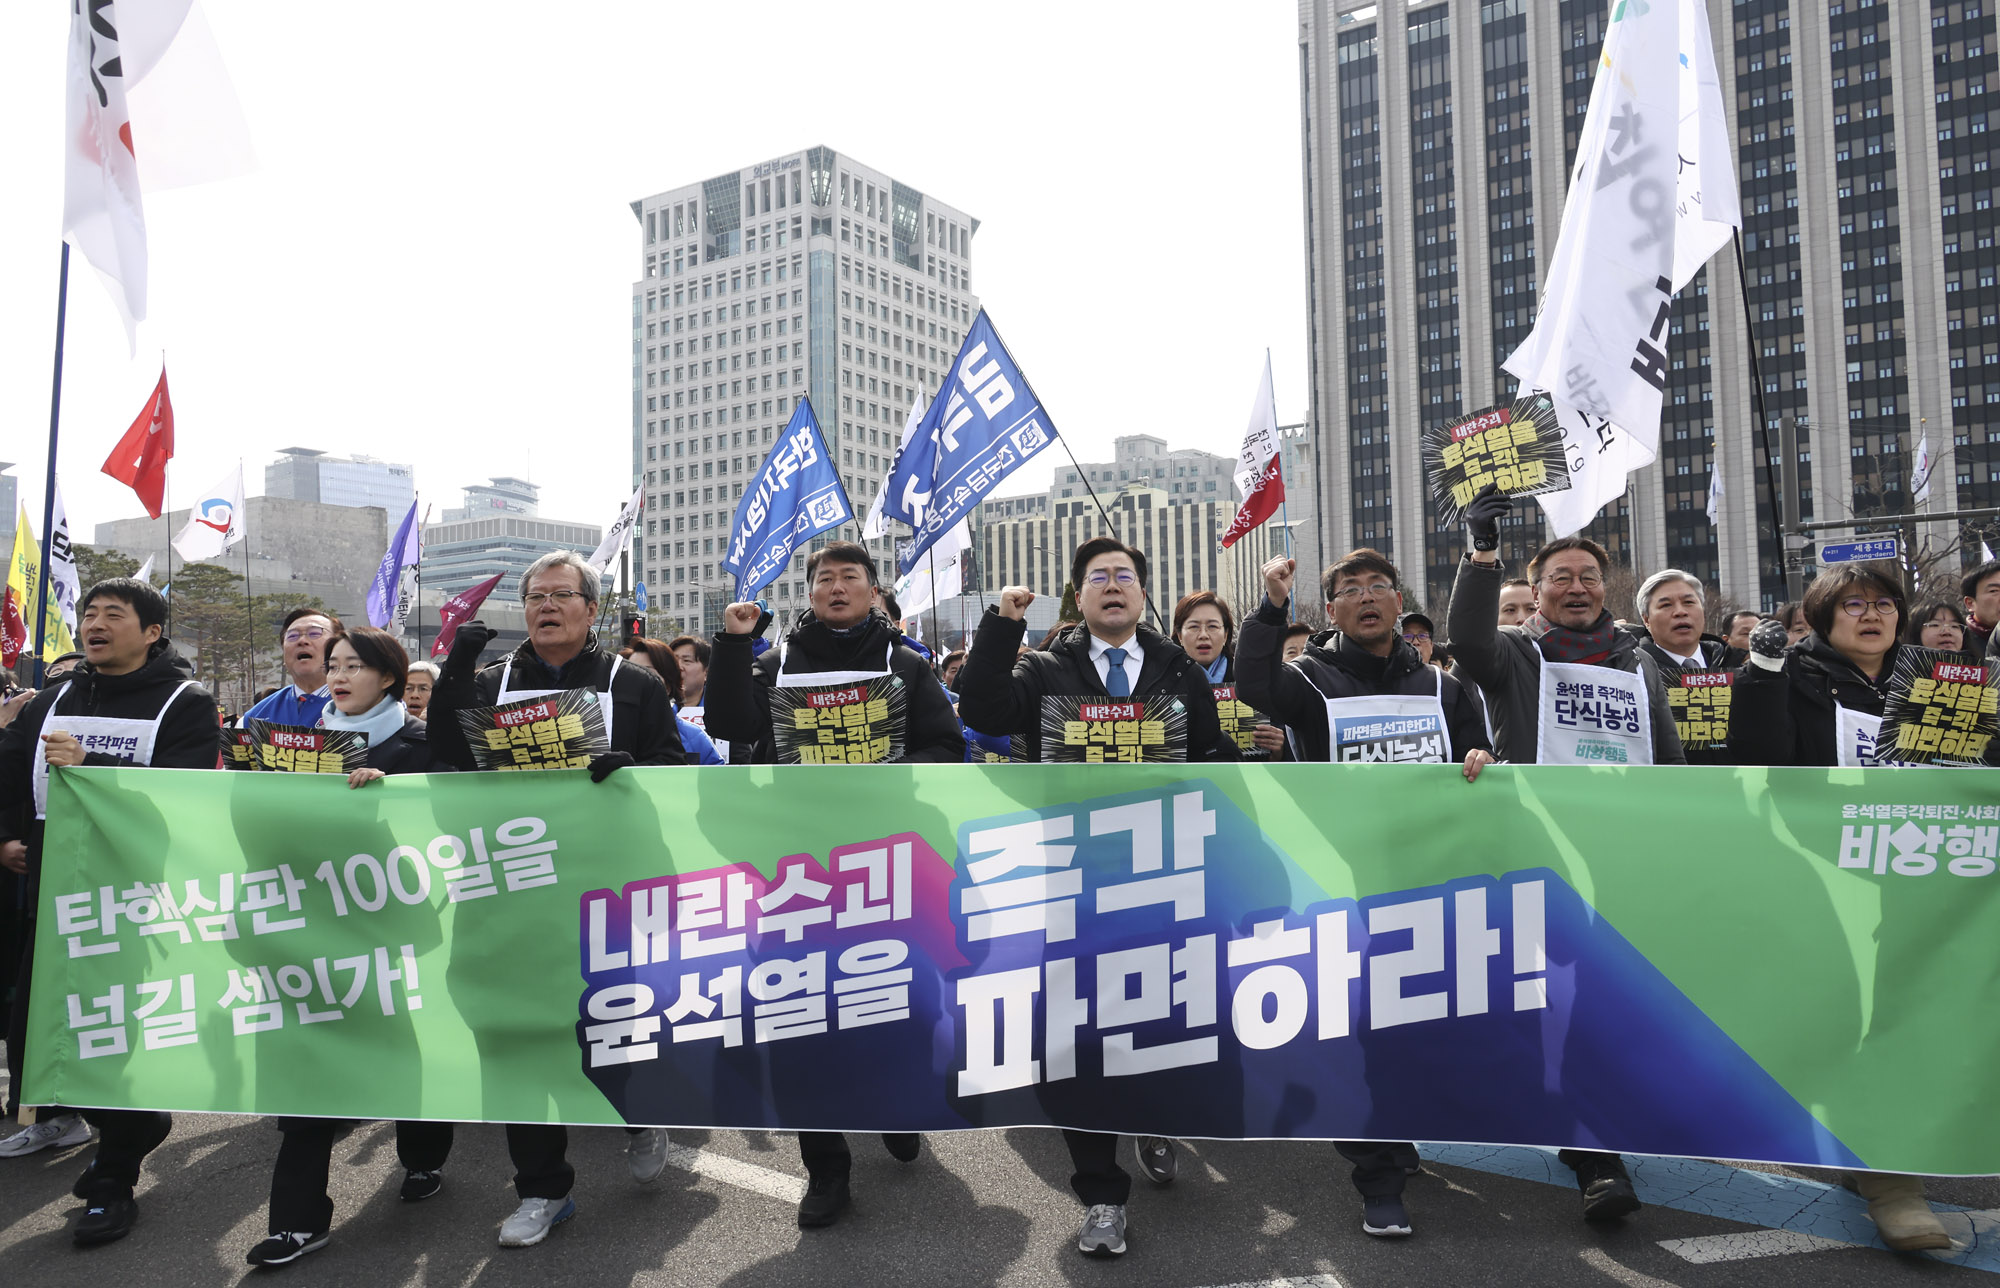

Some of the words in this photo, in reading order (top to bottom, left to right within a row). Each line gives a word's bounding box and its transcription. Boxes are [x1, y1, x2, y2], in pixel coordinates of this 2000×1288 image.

[754, 160, 780, 178] 외교부
[1455, 412, 1501, 438] 내란수괴
[1442, 420, 1538, 470] 윤석열을
[1452, 460, 1548, 508] 파면하라
[1850, 551, 1894, 560] Sejong-daero
[1854, 542, 1893, 552] 세종대로
[1687, 675, 1727, 686] 내란수괴
[1939, 665, 1982, 681] 내란수괴
[813, 689, 859, 706] 내란수괴
[1213, 688, 1231, 700] 수괴
[1555, 682, 1593, 698] 윤석열
[1598, 685, 1636, 705] 즉각파면
[1667, 685, 1732, 706] 윤석열
[1908, 677, 1999, 714] 윤석열을
[500, 704, 549, 725] 내란수괴
[794, 699, 889, 729] 윤석열을
[1086, 705, 1135, 719] 내란수괴
[1216, 699, 1254, 719] 열을
[1555, 700, 1640, 733] 단식농성
[85, 734, 138, 751] 즉각파면
[274, 732, 315, 748] 내란수괴
[484, 714, 585, 750] 윤석열을
[1064, 720, 1165, 745] 윤석열을
[1677, 721, 1729, 741] 파면하
[1896, 723, 1992, 757] 파면하라
[261, 744, 344, 773] 윤석열을
[798, 735, 891, 764] 파면하라
[1575, 744, 1628, 762] 비상행동
[1838, 820, 2000, 877] 비상행
[961, 790, 1216, 944] 즉각
[55, 862, 306, 958] 탄핵심판
[315, 816, 558, 917] 100일을
[589, 841, 912, 973] 내란수괴
[957, 879, 1547, 1098] 파면하라!
[66, 972, 199, 1060] 넘길
[217, 943, 424, 1037] 셈인가!
[584, 938, 913, 1068] 윤석열을
